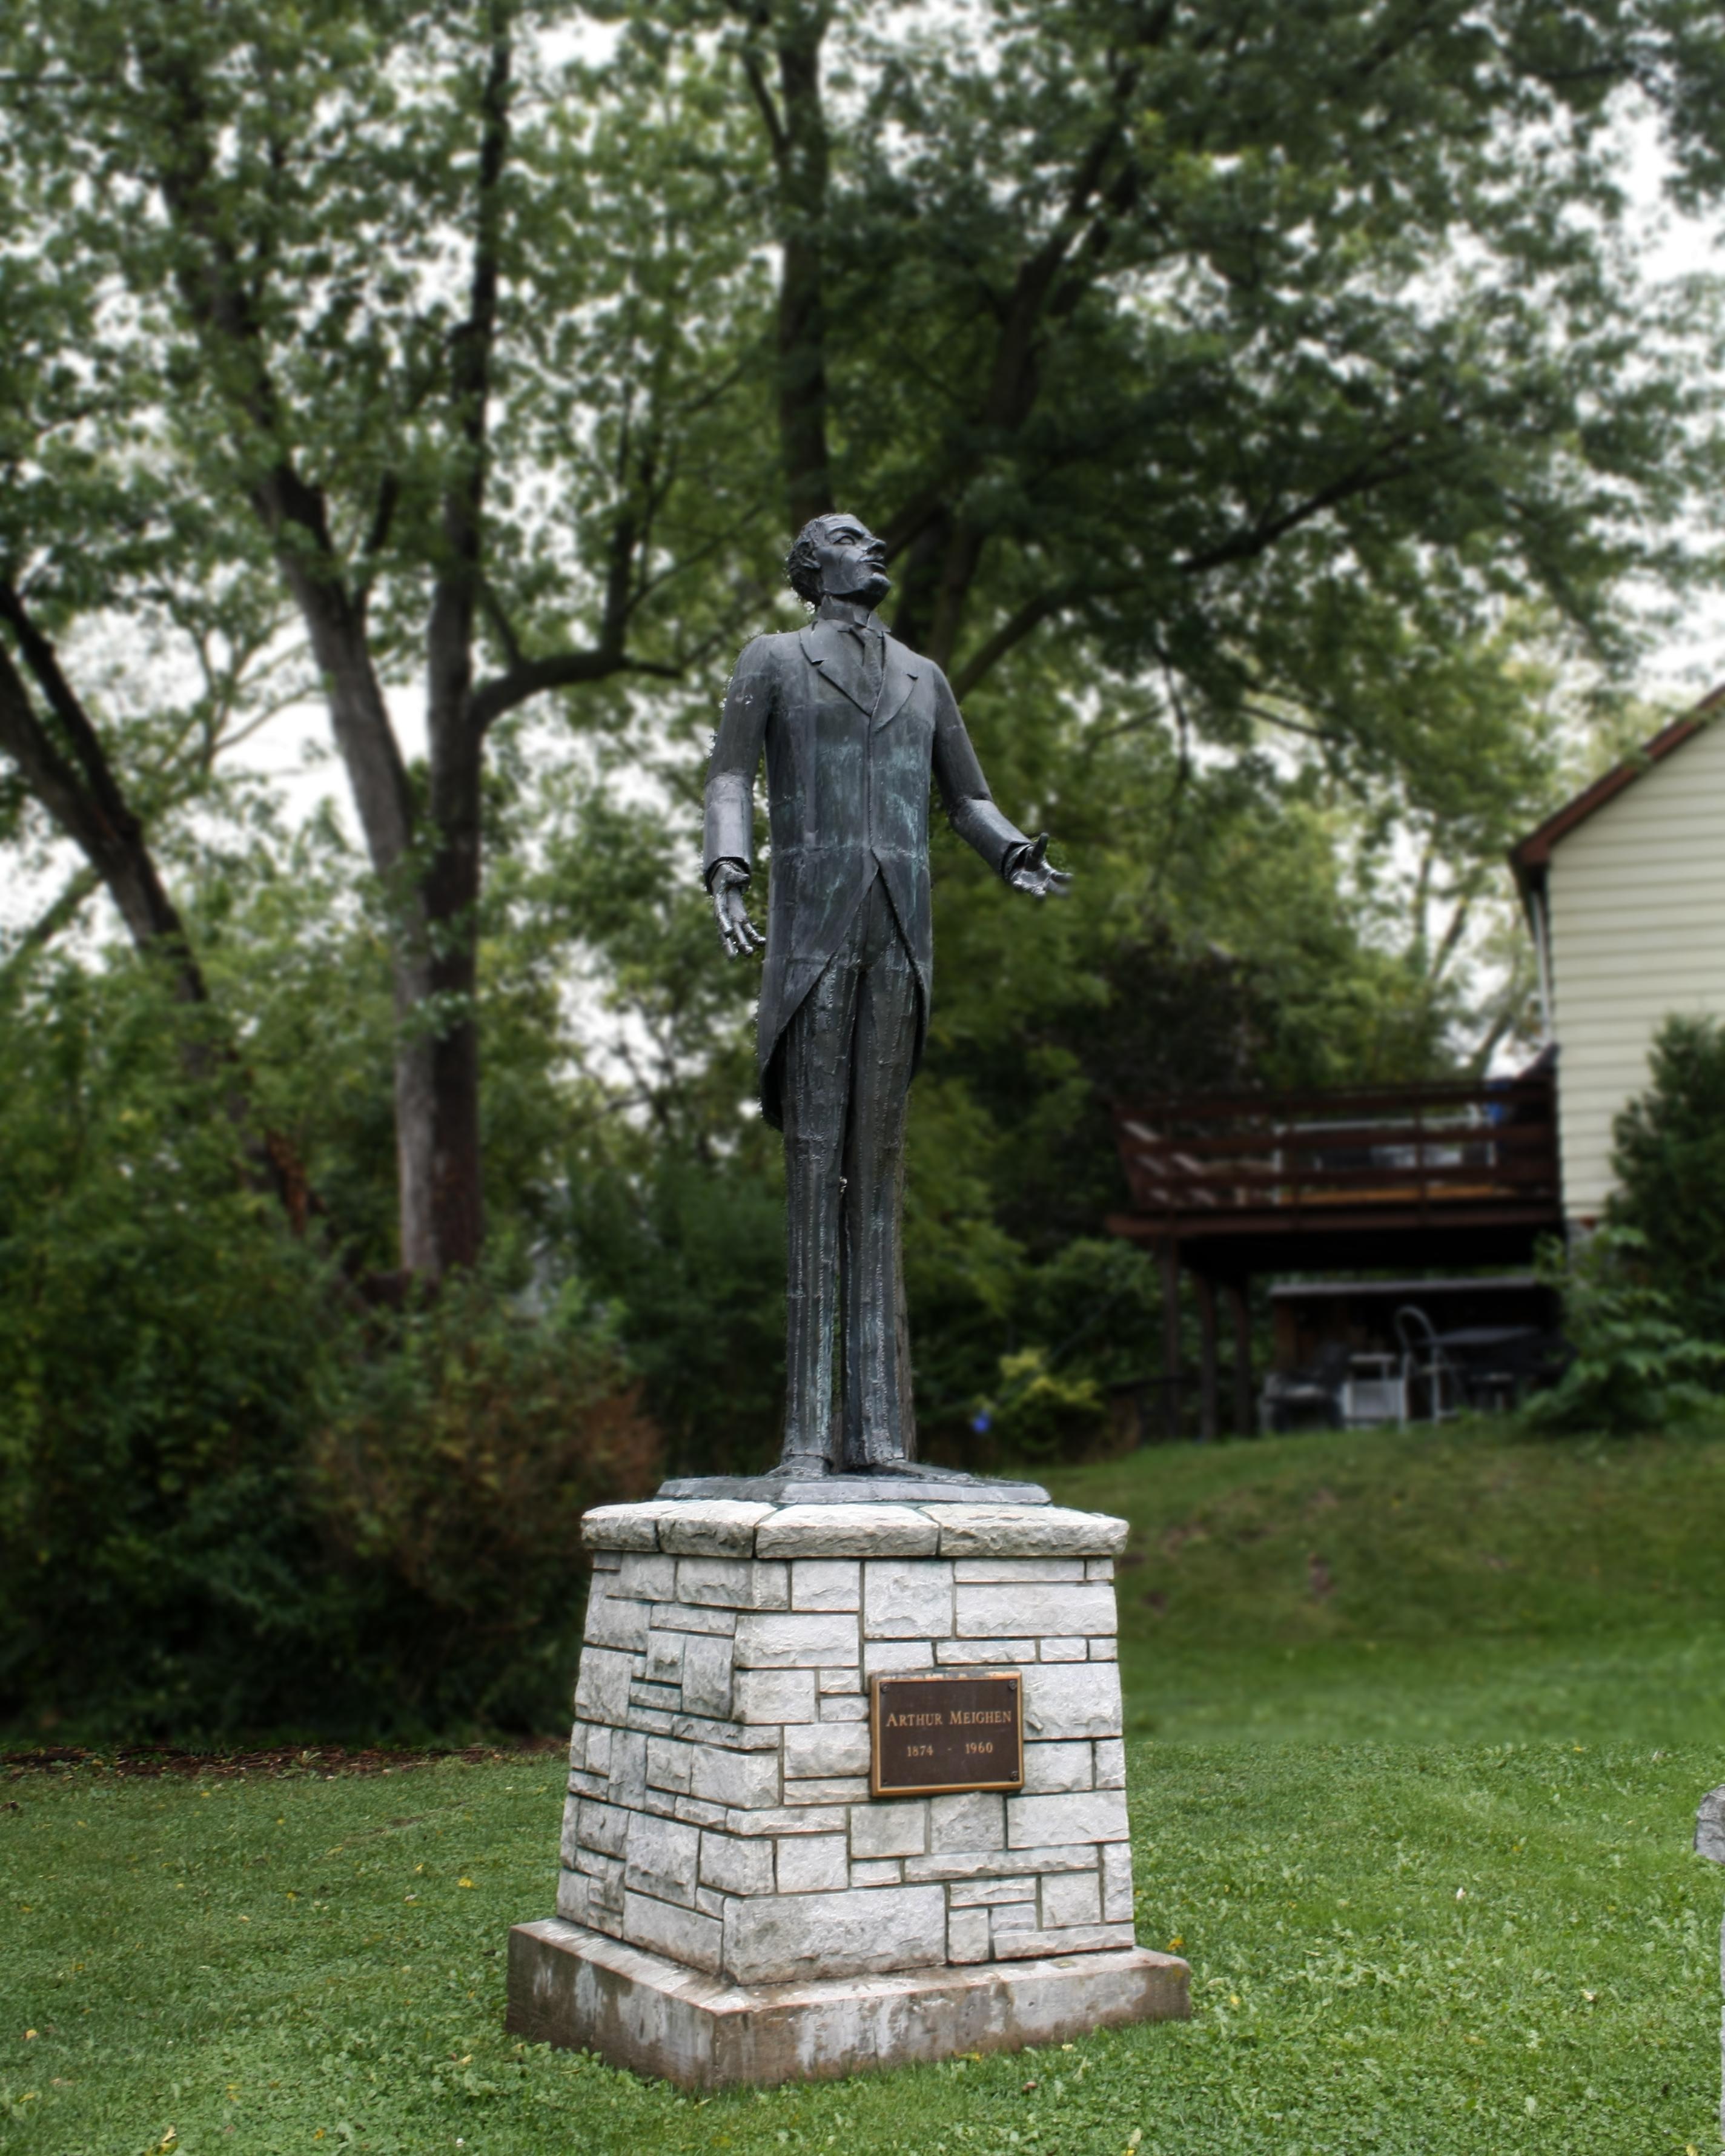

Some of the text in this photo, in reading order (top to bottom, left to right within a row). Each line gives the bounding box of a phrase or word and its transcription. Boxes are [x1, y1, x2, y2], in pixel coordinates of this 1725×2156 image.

[886, 1710, 1011, 1727] ARTHUR MEIGHEN
[907, 1745, 934, 1756] 1874
[965, 1741, 993, 1754] 1960
